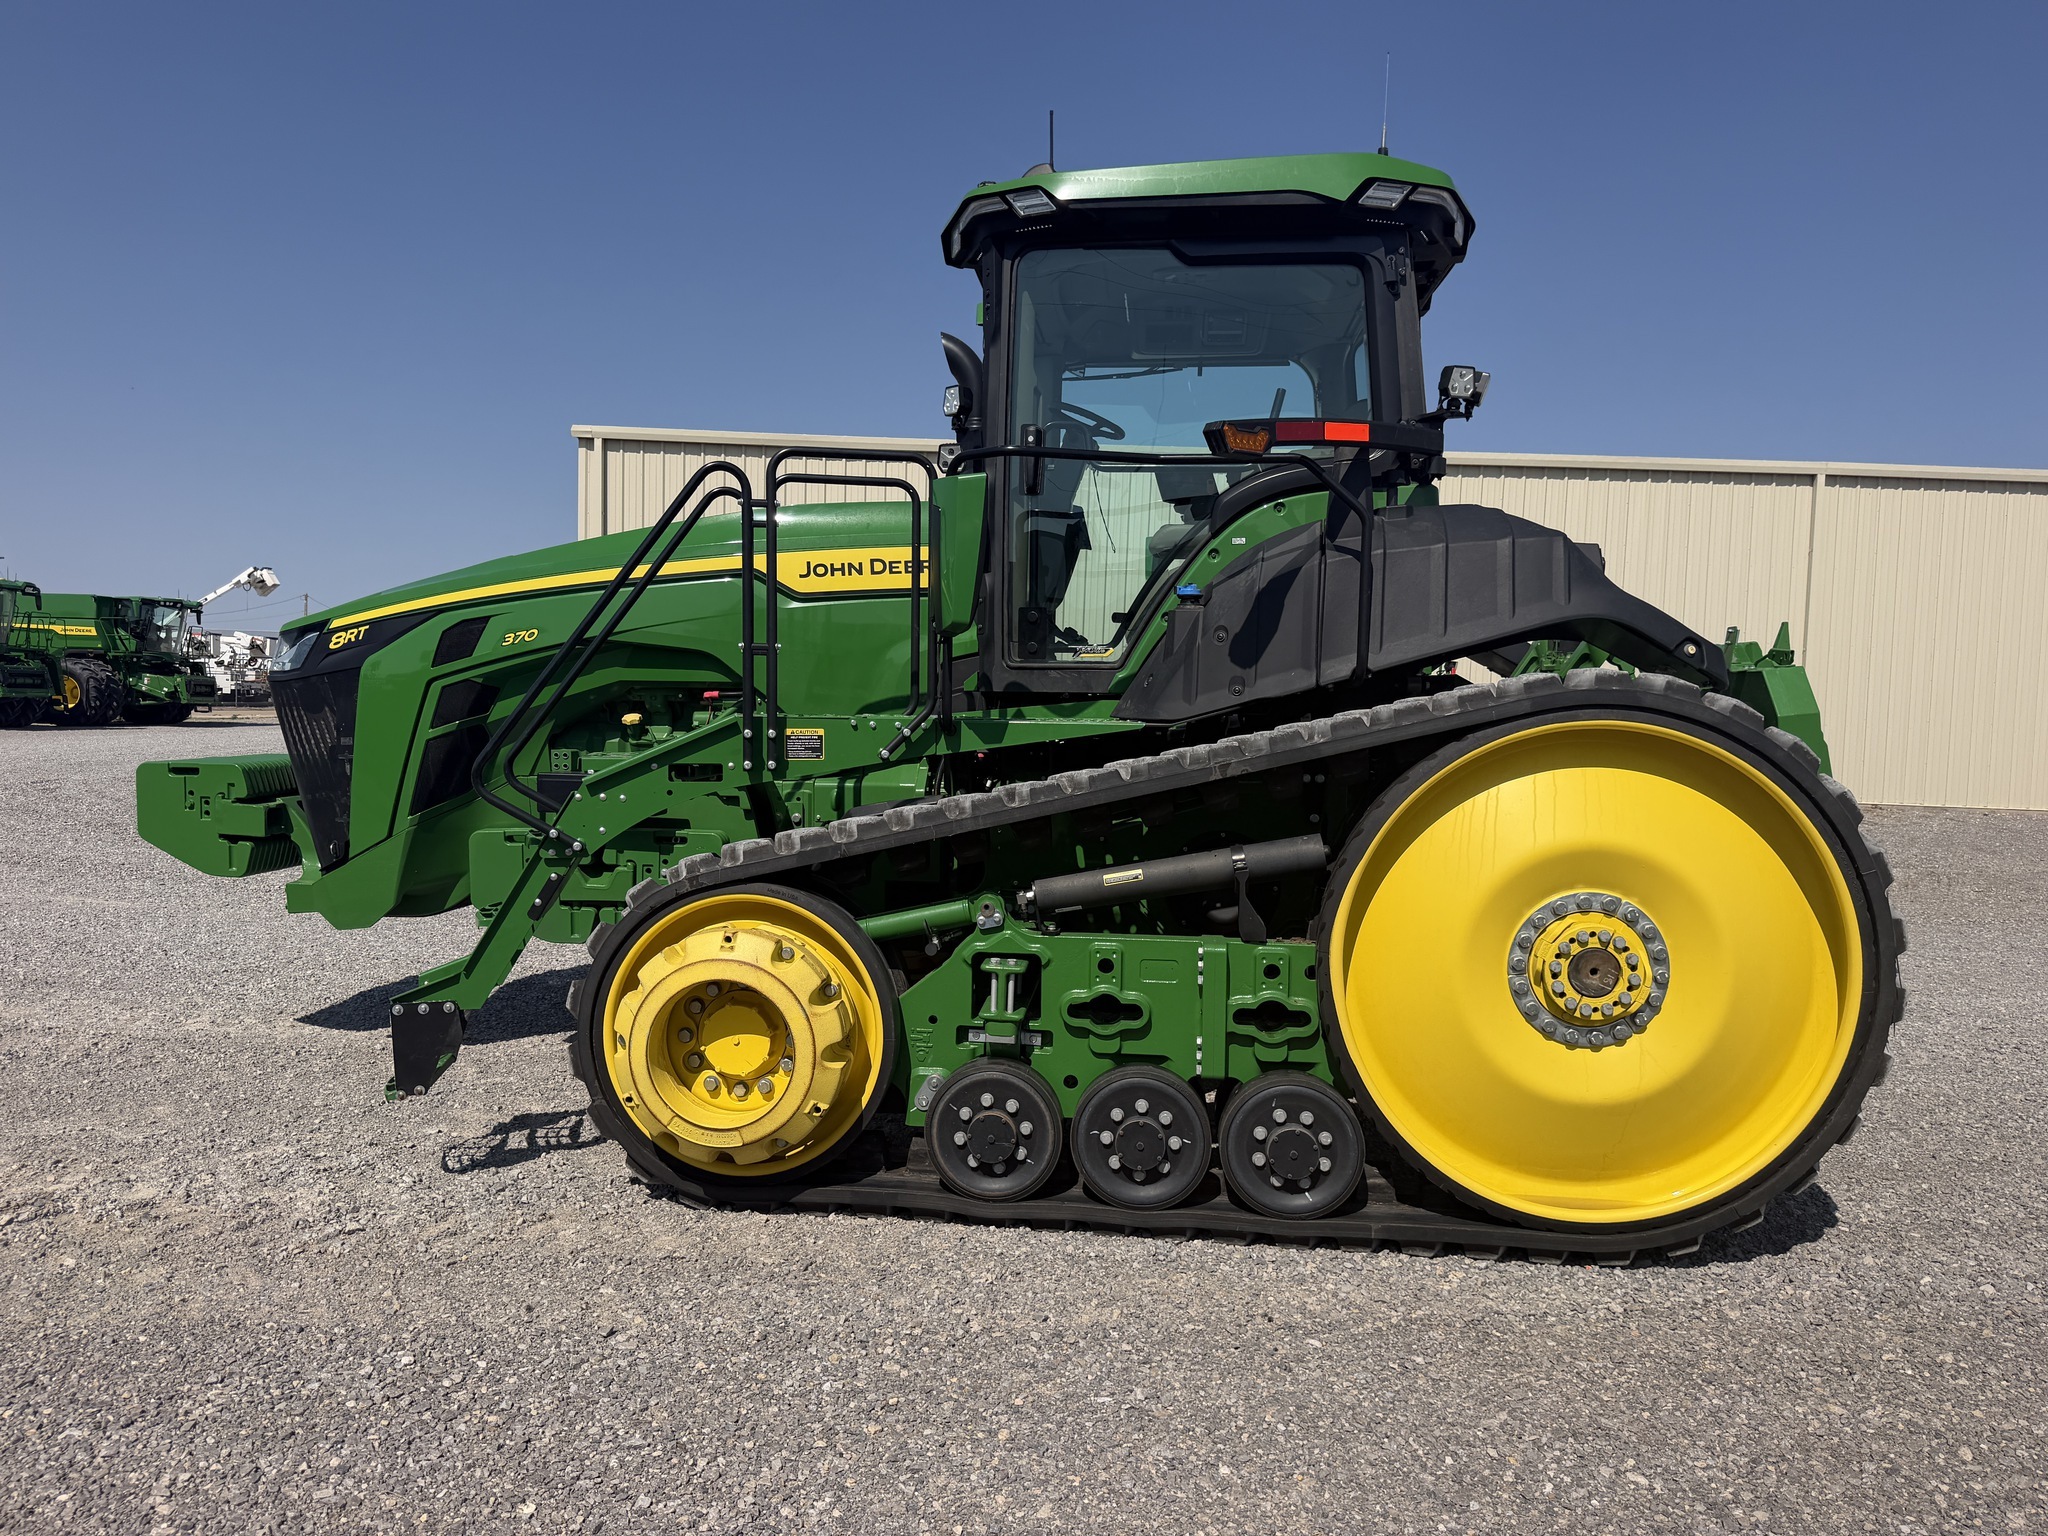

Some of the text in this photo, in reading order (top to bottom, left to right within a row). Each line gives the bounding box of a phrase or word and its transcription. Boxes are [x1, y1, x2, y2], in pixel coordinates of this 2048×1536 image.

[798, 561, 864, 578] JOHN
[329, 625, 370, 649] 8RT
[501, 629, 539, 646] 370
